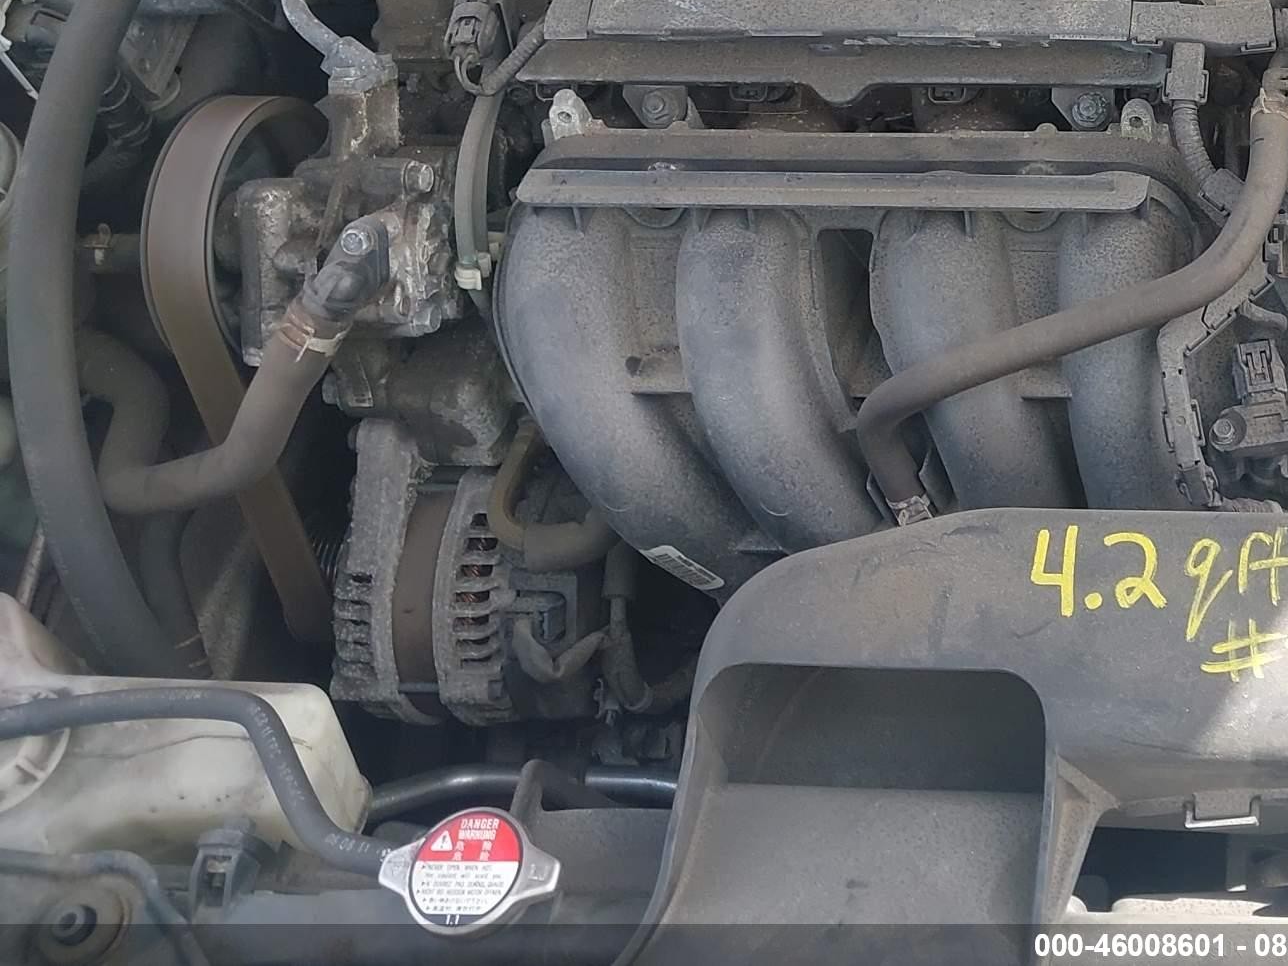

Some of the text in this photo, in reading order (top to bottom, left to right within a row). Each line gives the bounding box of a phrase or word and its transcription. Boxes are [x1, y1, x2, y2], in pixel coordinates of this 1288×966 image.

[1030, 525, 1168, 618] 4.2
[460, 818, 500, 830] DANGER
[446, 914, 460, 925] 1.1
